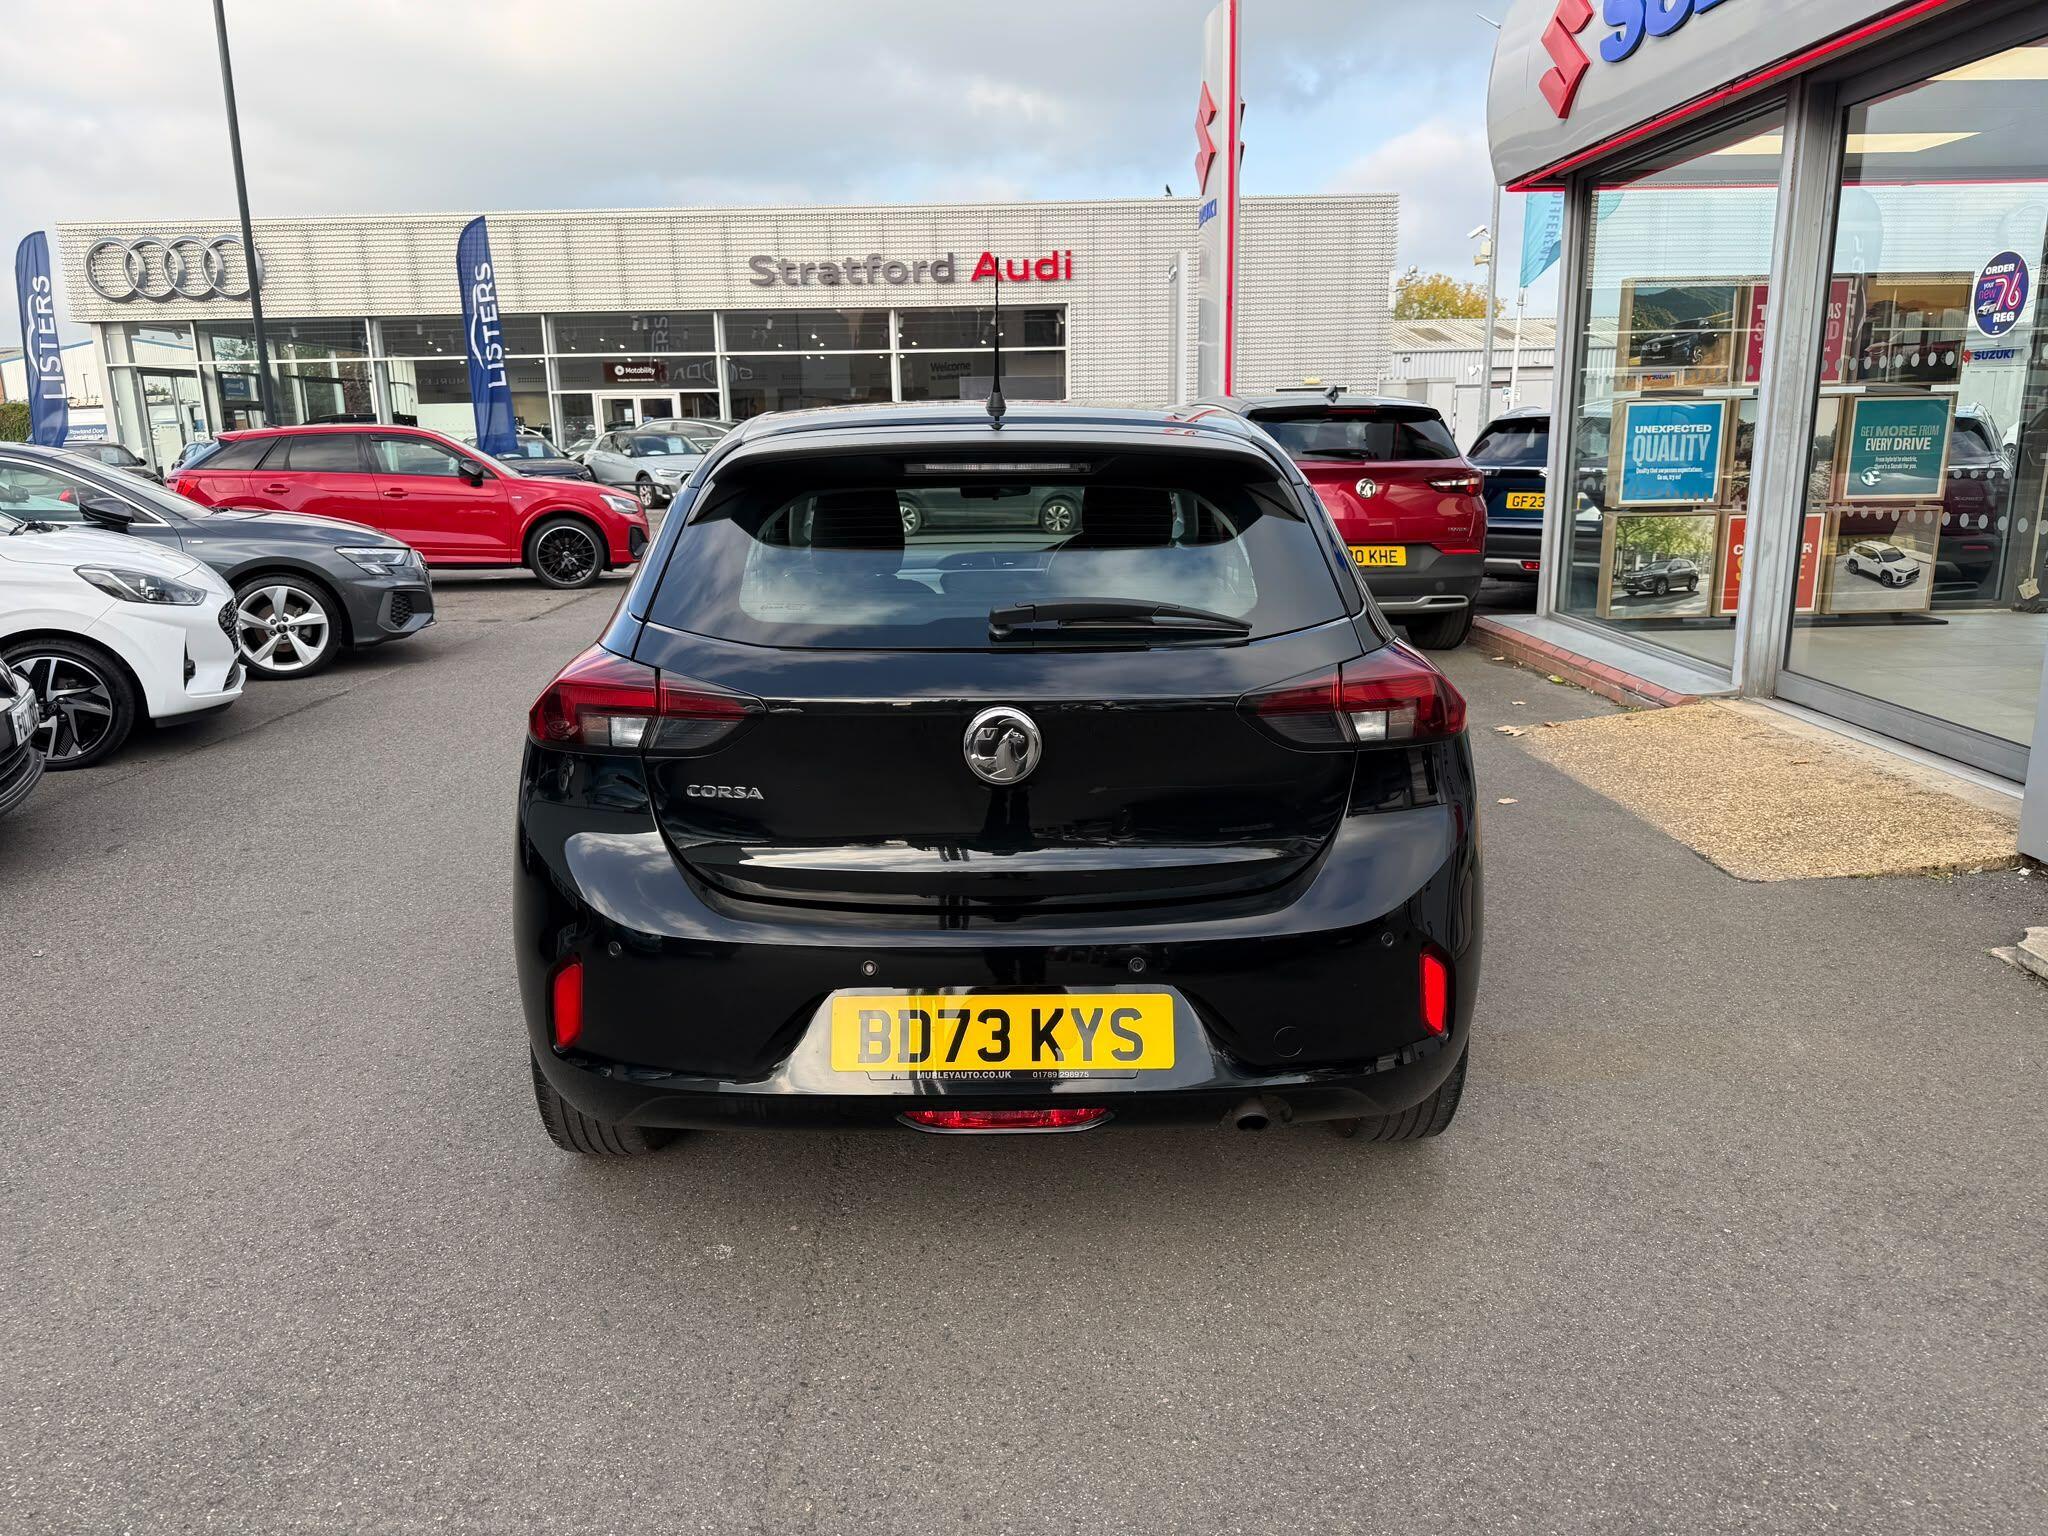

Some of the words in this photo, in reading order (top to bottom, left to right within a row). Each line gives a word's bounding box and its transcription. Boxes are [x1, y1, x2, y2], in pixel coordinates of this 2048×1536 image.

[748, 252, 955, 287] Stratford
[970, 250, 1072, 283] Audi
[1985, 263, 2016, 276] ORDER
[1983, 280, 1996, 291] your
[1994, 271, 2022, 311] 76
[1978, 288, 1997, 300] new
[1992, 311, 2016, 324] REG
[475, 262, 507, 388] LISTERS
[32, 275, 67, 400] LISTERS
[1973, 348, 2016, 361] SUZUKI
[625, 366, 656, 376] Motability
[930, 361, 971, 372] Welcome
[1634, 424, 1712, 434] UNEXPECTED
[1860, 425, 1875, 437] GET
[1875, 425, 1917, 437] MORE
[1918, 424, 1940, 436] FROM
[1632, 433, 1711, 467] QUALITY
[1865, 438, 1893, 451] EVERY
[1893, 437, 1932, 450] DRIVE
[1512, 495, 1545, 507] GF23
[1369, 549, 1398, 564] KHE
[686, 784, 765, 800] CORSA
[857, 1007, 1011, 1064] BD73
[1031, 1007, 1144, 1063] KYS
[1032, 1071, 1058, 1079] 01789
